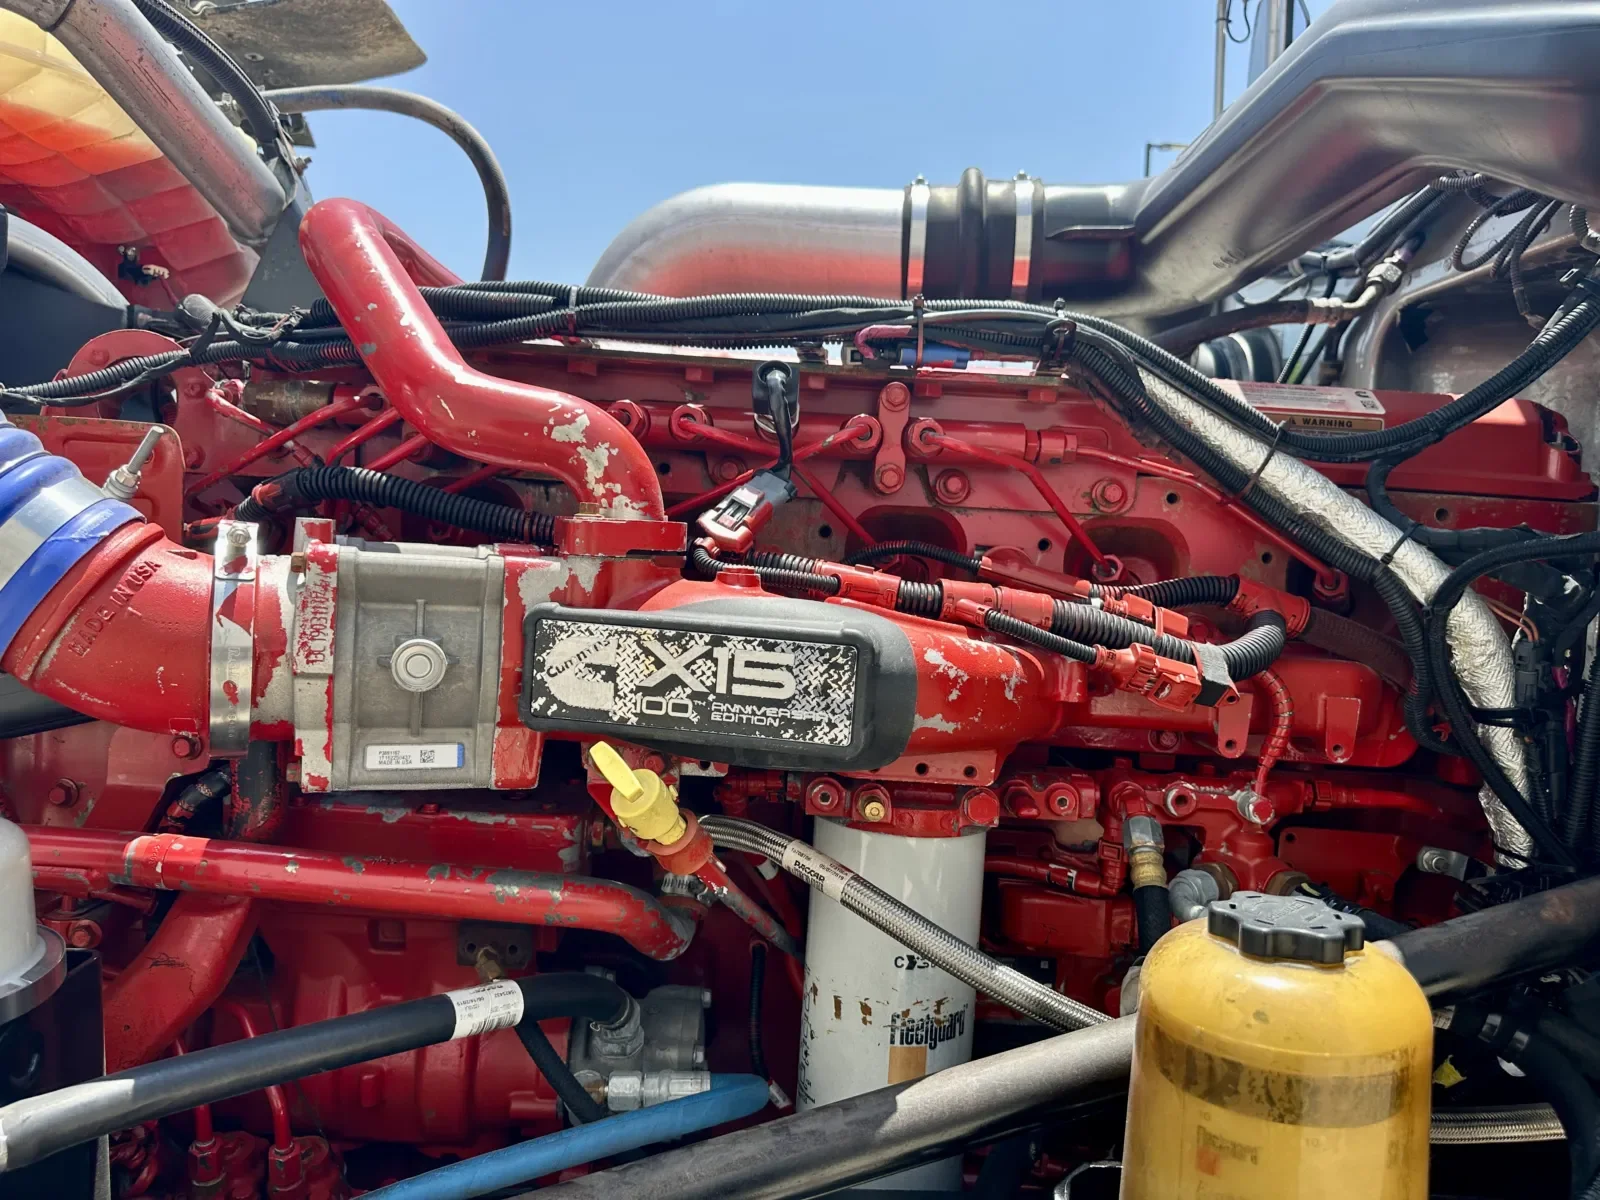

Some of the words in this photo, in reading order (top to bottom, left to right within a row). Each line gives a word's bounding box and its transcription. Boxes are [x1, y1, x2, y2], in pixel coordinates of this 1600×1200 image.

[1302, 417, 1353, 429] WARNING
[68, 603, 116, 658] MADE
[109, 583, 135, 607] IN
[126, 561, 163, 586] USA
[636, 640, 796, 699] X15
[710, 712, 780, 728] EDITION
[794, 860, 825, 882] PACCAR
